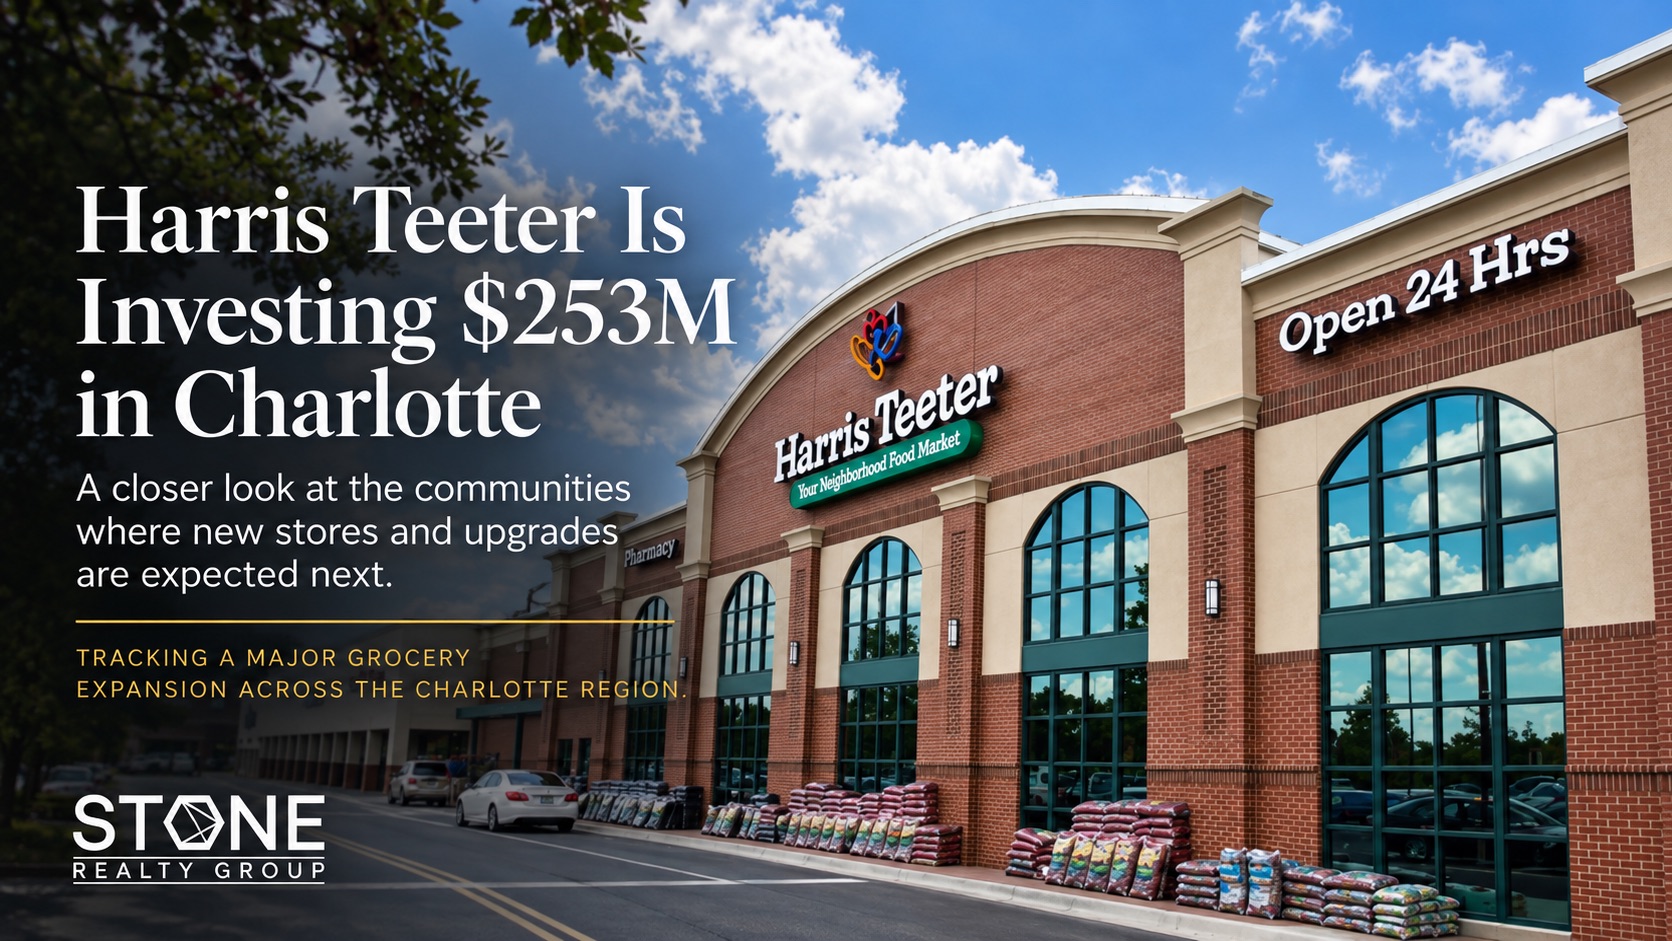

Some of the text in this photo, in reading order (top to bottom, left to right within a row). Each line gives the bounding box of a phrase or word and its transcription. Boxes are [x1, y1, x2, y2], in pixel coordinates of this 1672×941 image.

[1279, 228, 1570, 355] Open 24 Hrs
[774, 365, 999, 483] Harris Teeter
[798, 430, 961, 499] Your Neighborhood Food Market
[624, 539, 676, 568] Pharmacy
